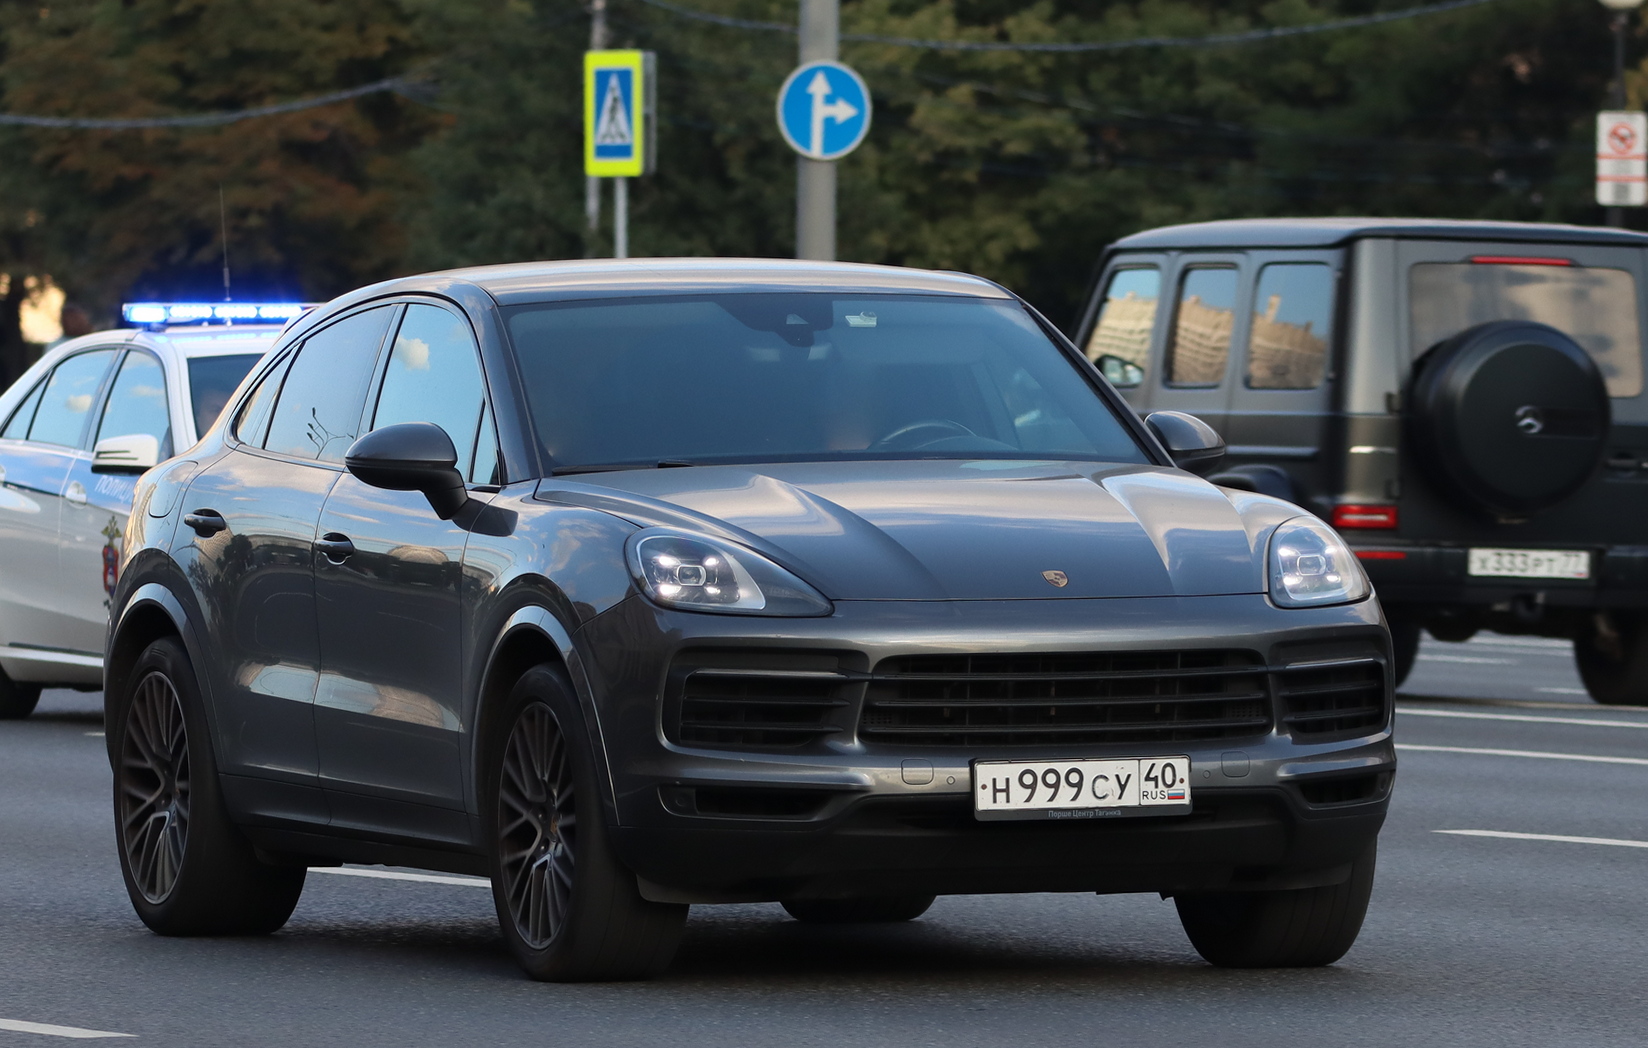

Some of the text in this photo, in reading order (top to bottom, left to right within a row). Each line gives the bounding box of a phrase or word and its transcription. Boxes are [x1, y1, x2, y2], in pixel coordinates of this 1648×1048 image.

[1144, 762, 1177, 789] 40
[1142, 789, 1167, 800] RUS
[1048, 810, 1071, 819] Порше
[1072, 809, 1094, 818] Центр
